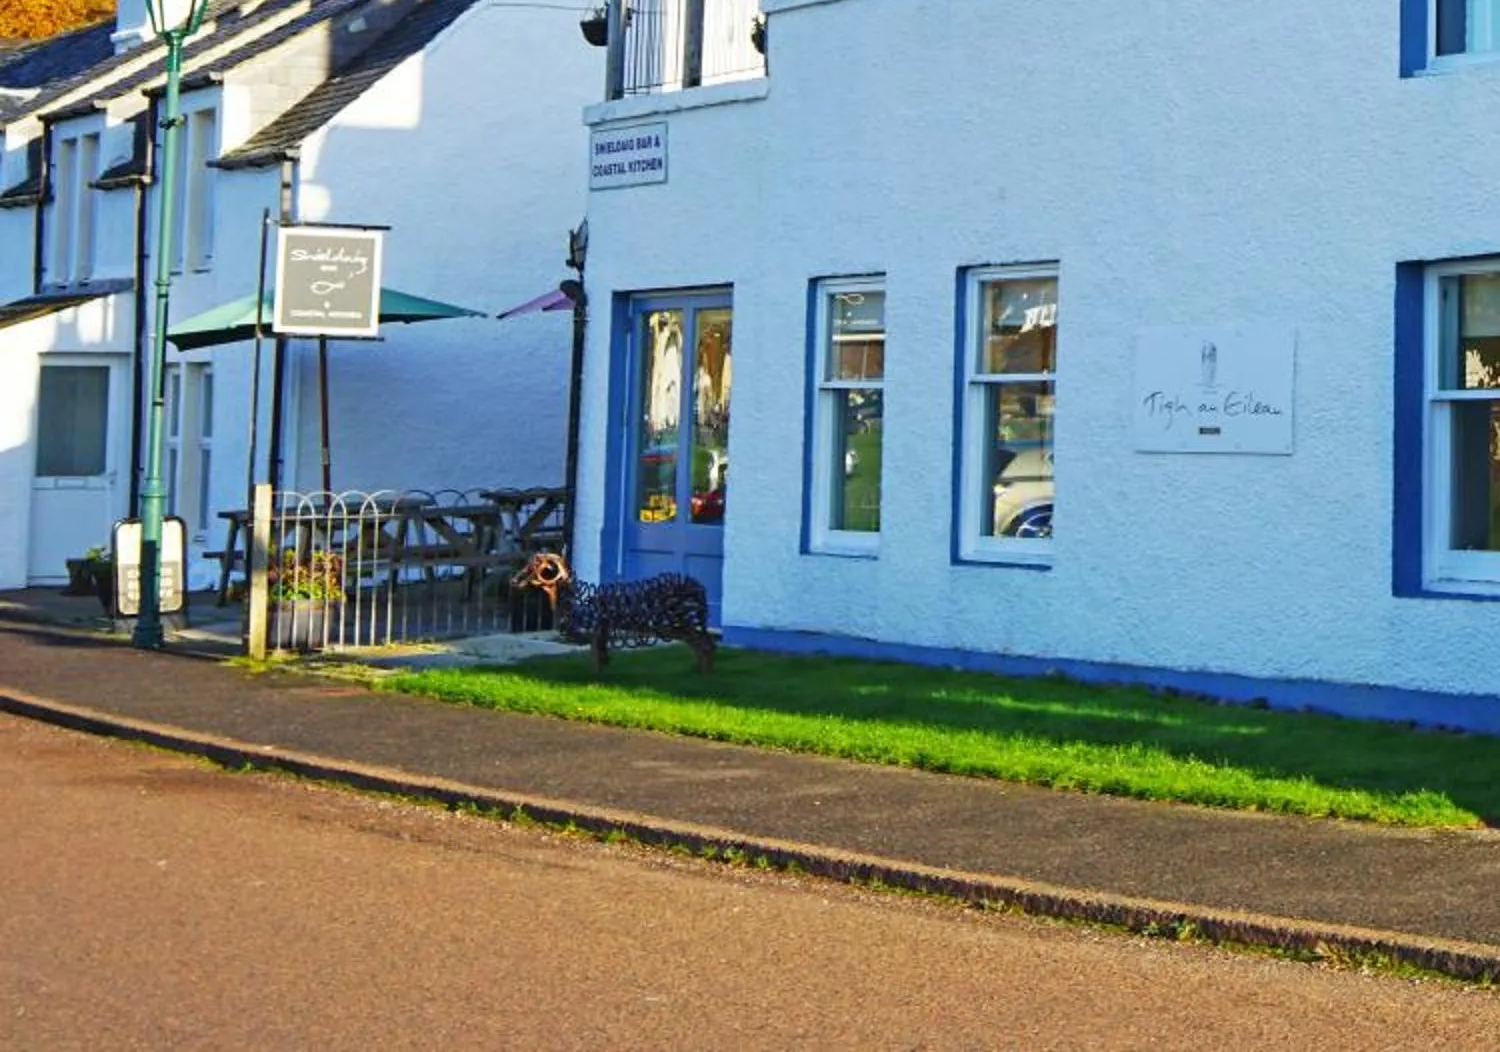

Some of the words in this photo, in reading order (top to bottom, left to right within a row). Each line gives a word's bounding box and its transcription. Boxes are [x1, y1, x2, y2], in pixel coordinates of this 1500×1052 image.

[636, 135, 652, 150] BAR
[592, 162, 627, 177] COASTAL
[628, 157, 662, 172] KITCHEN
[1143, 391, 1193, 431] Tigh
